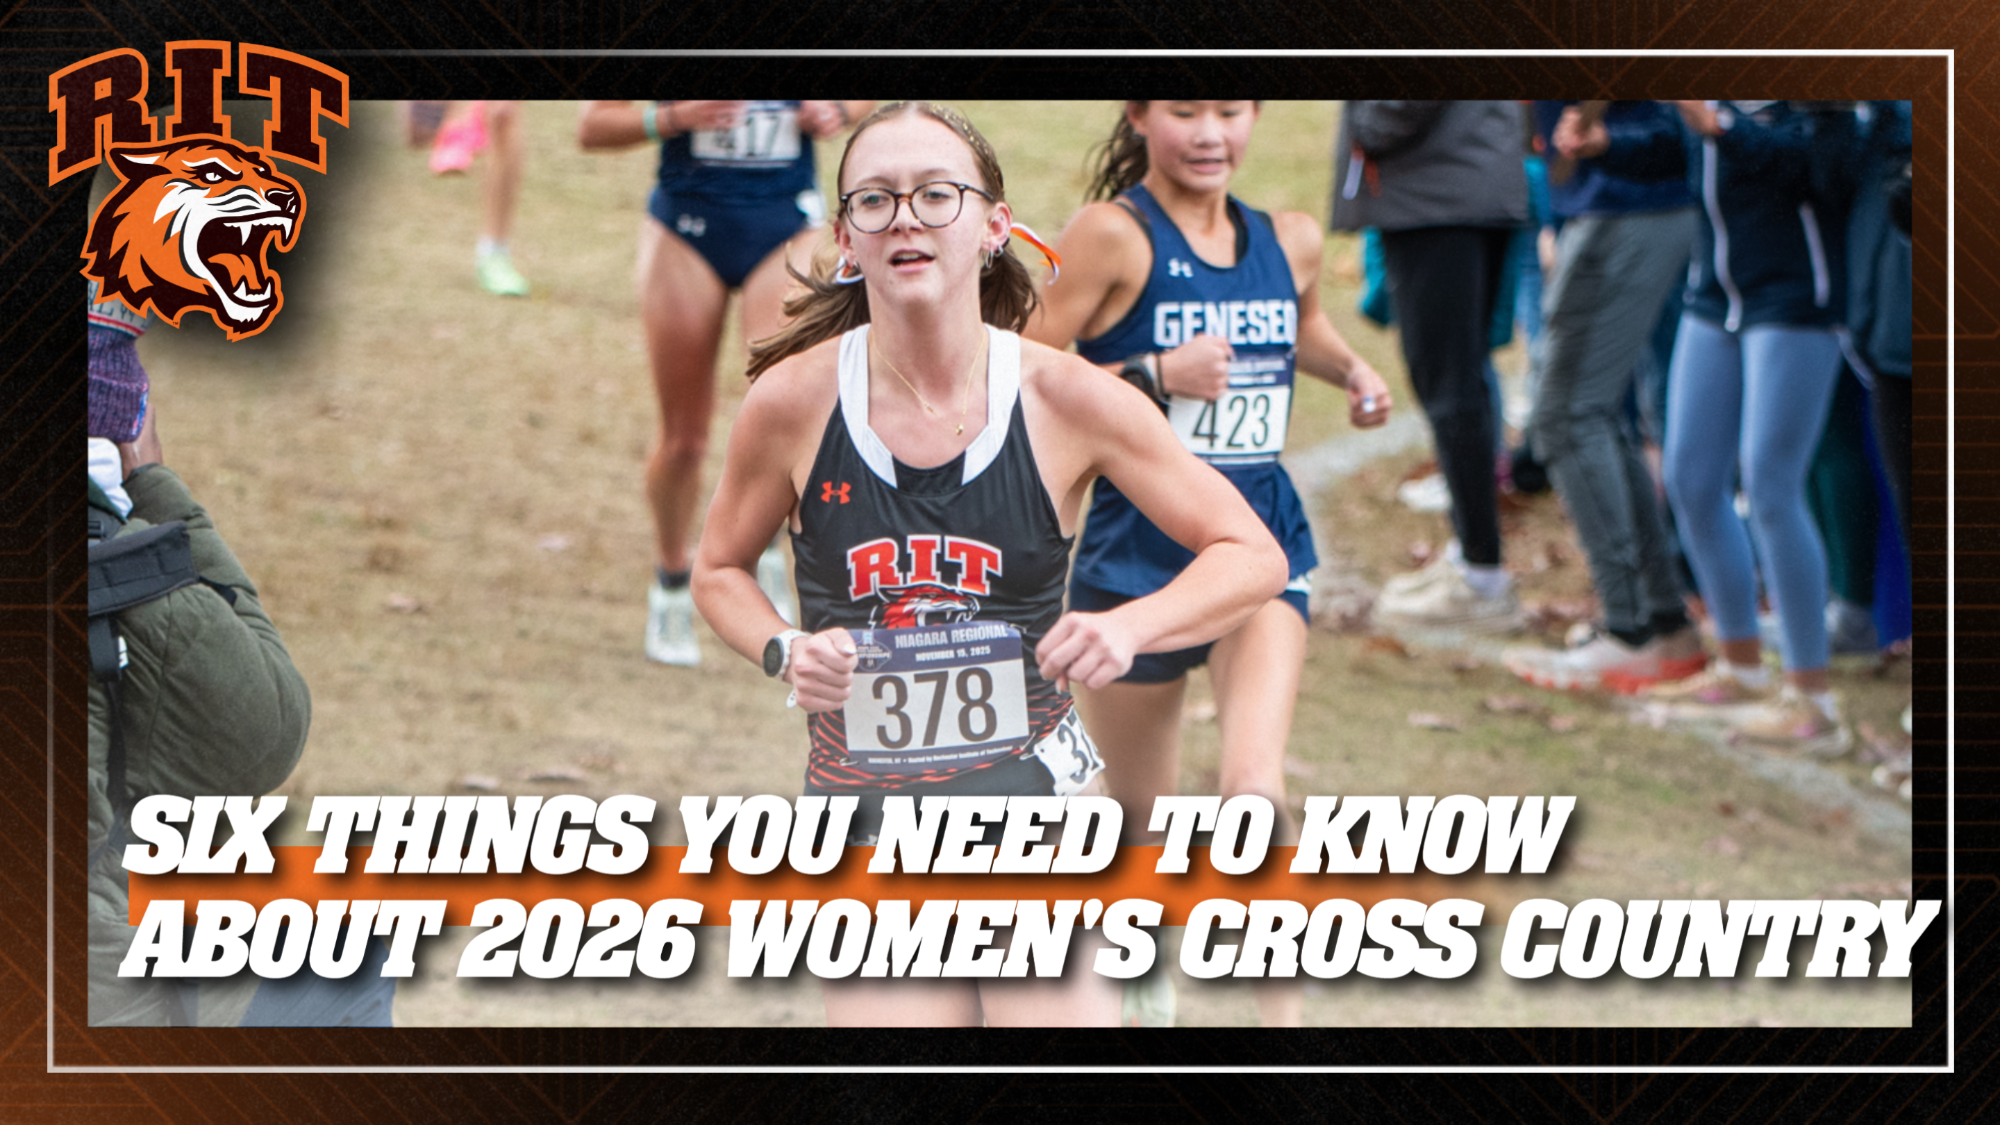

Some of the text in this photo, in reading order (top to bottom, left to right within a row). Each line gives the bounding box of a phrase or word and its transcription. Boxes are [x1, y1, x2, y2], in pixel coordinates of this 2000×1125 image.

[1191, 394, 1271, 449] 423
[847, 534, 1003, 602] RIT
[895, 624, 1009, 649] NIAGARA REGIONAL
[915, 649, 955, 663] NOVEMBER
[970, 645, 991, 657] 2025
[871, 666, 998, 750] 378
